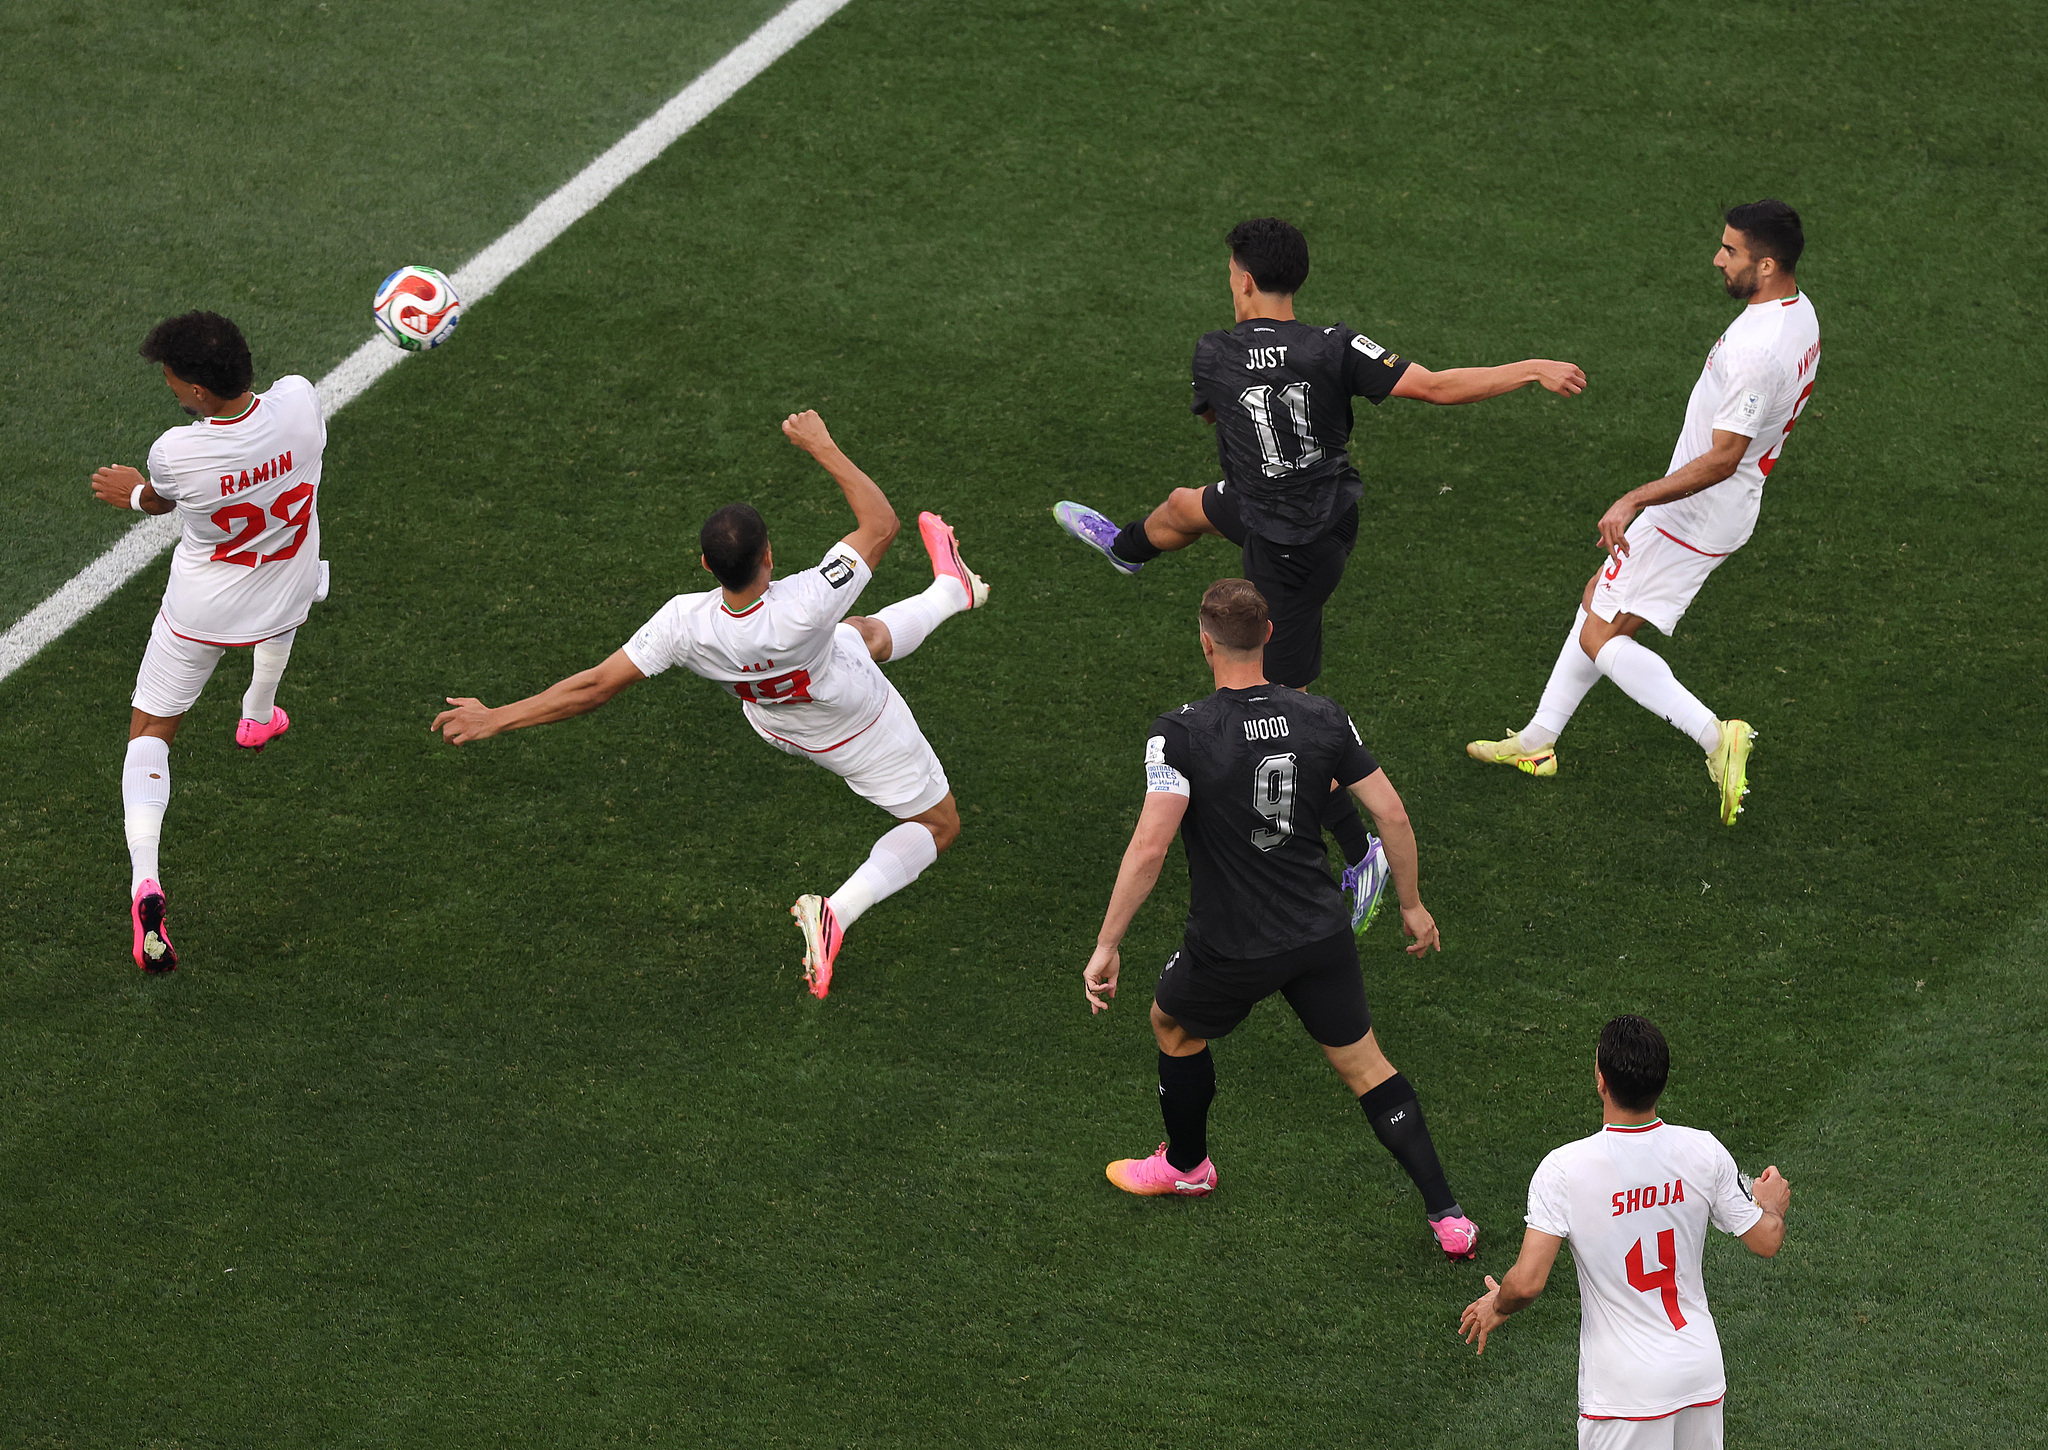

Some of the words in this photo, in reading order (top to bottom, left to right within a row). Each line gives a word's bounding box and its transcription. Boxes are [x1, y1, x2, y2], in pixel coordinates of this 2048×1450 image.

[1245, 346, 1288, 370] JUST
[1237, 381, 1326, 479] 11
[219, 450, 293, 497] RAMIN
[1243, 715, 1290, 741] WOOD
[1149, 771, 1177, 780] UNITES
[1250, 752, 1298, 853] 9
[1390, 1110, 1406, 1125] NZ
[1611, 1178, 1685, 1217] SHOJA
[1624, 1228, 1688, 1331] 4
